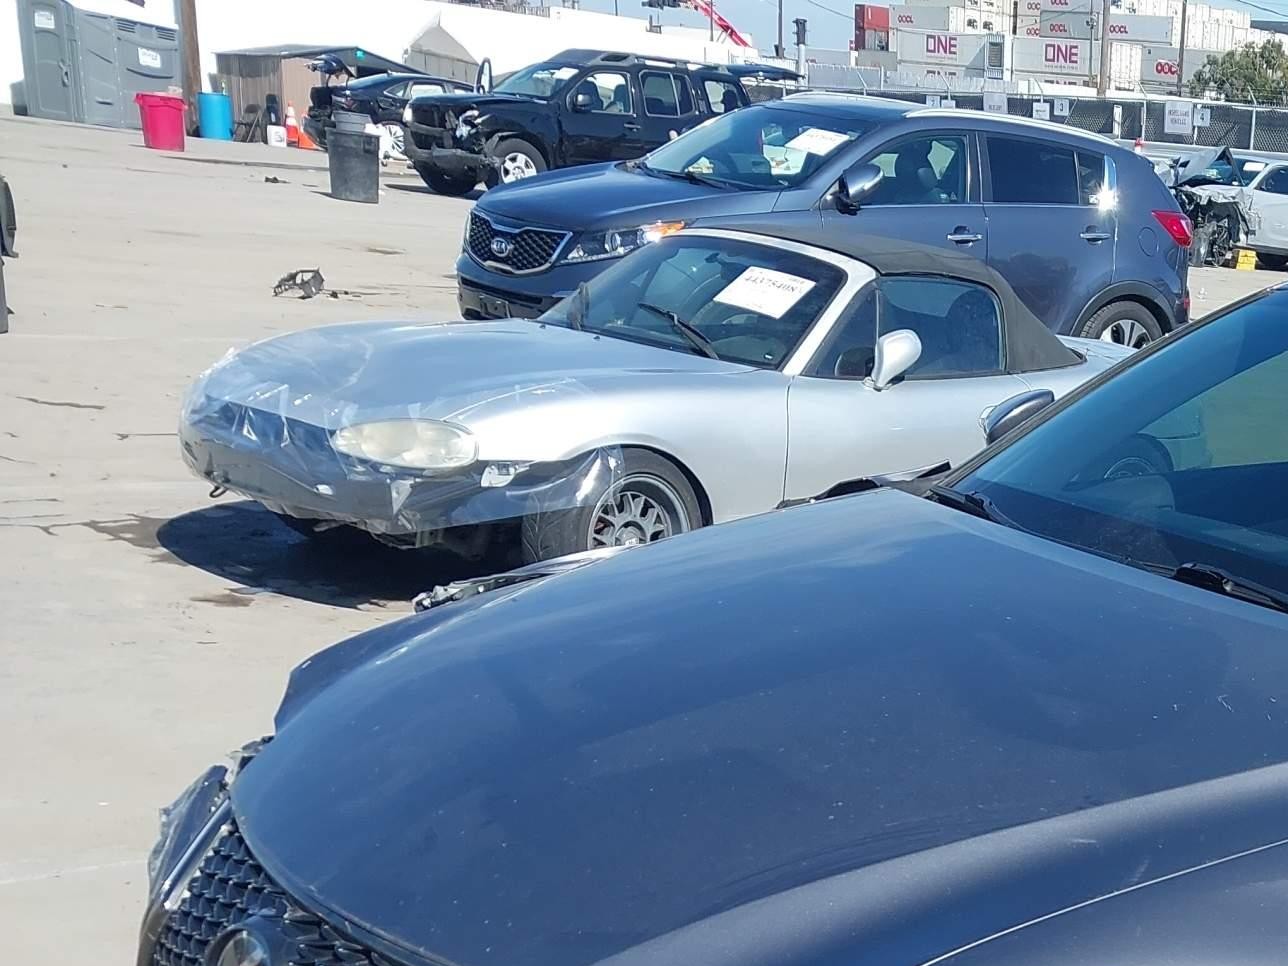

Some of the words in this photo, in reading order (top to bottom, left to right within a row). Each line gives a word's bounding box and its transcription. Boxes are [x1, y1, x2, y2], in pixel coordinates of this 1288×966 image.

[1049, 23, 1067, 32] OOCL
[1109, 24, 1128, 33] OOCL
[926, 34, 957, 54] ONE
[1044, 43, 1078, 64] ONE
